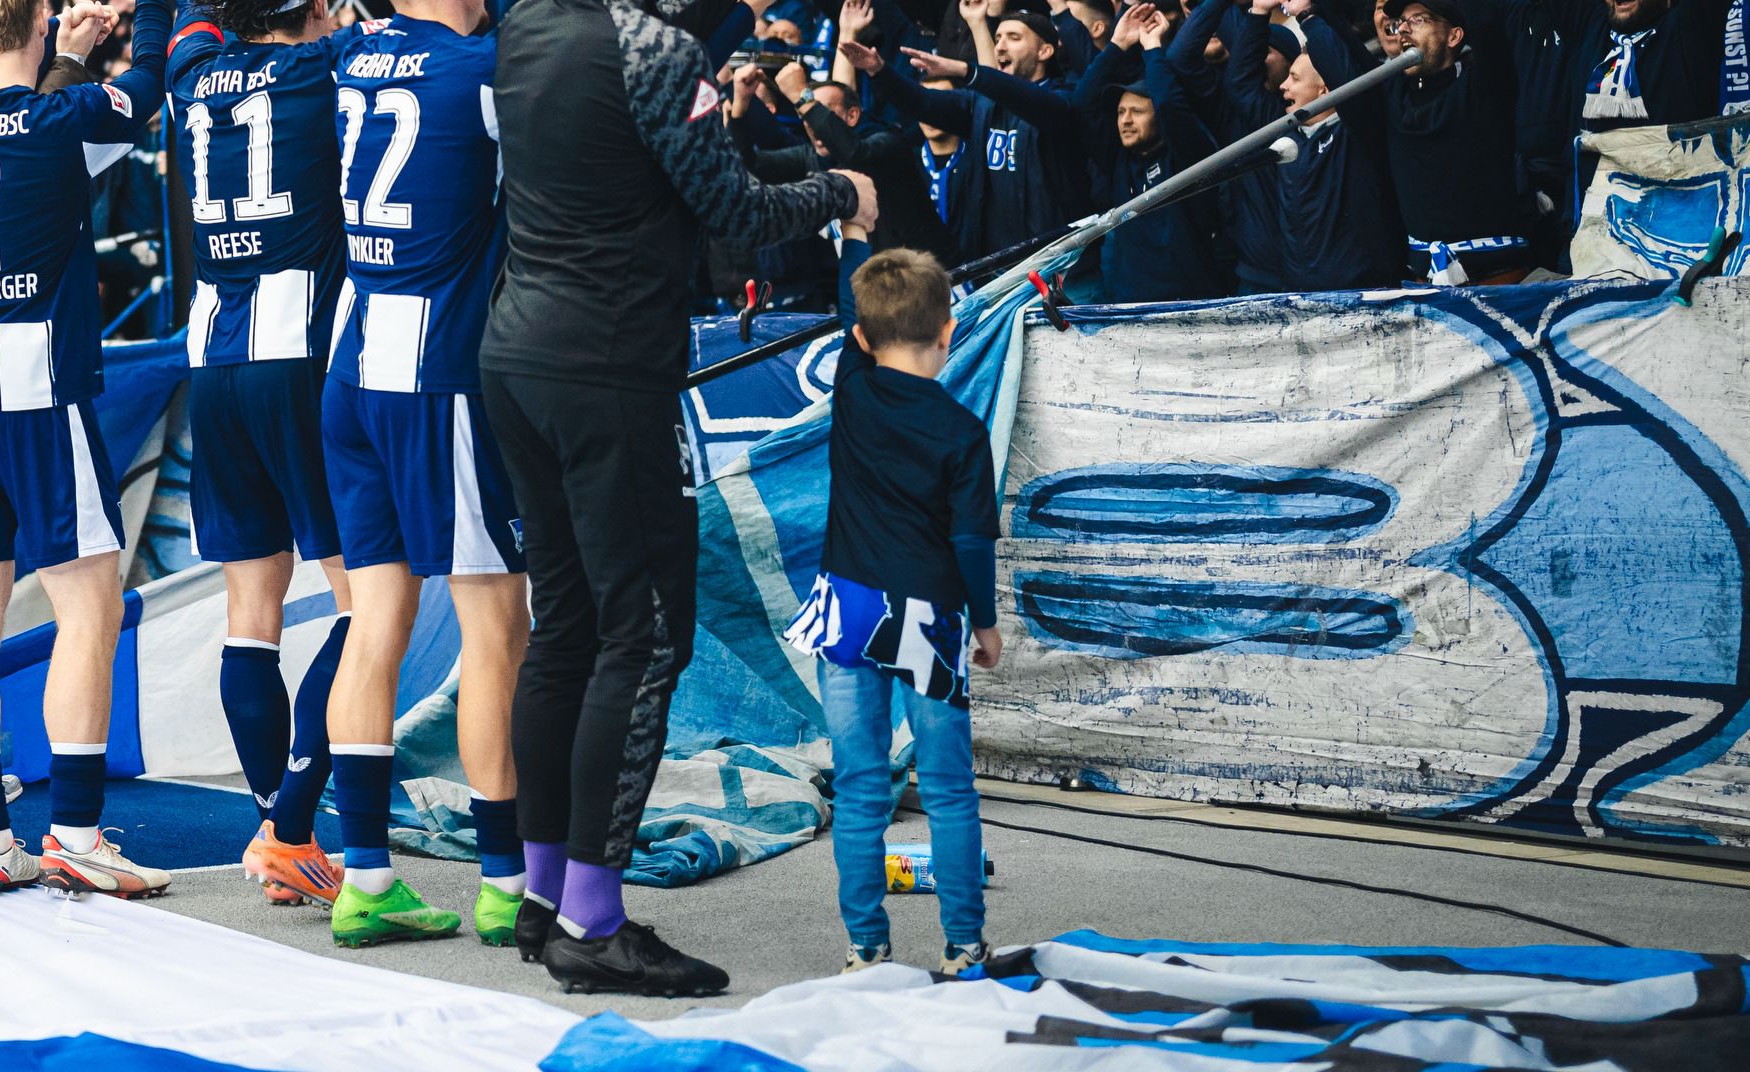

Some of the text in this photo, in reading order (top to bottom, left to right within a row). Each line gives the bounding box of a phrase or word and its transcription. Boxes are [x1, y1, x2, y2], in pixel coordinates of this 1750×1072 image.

[246, 60, 277, 91] BSC
[394, 52, 430, 78] BSC
[185, 90, 294, 224] 11
[208, 231, 263, 259] REESE
